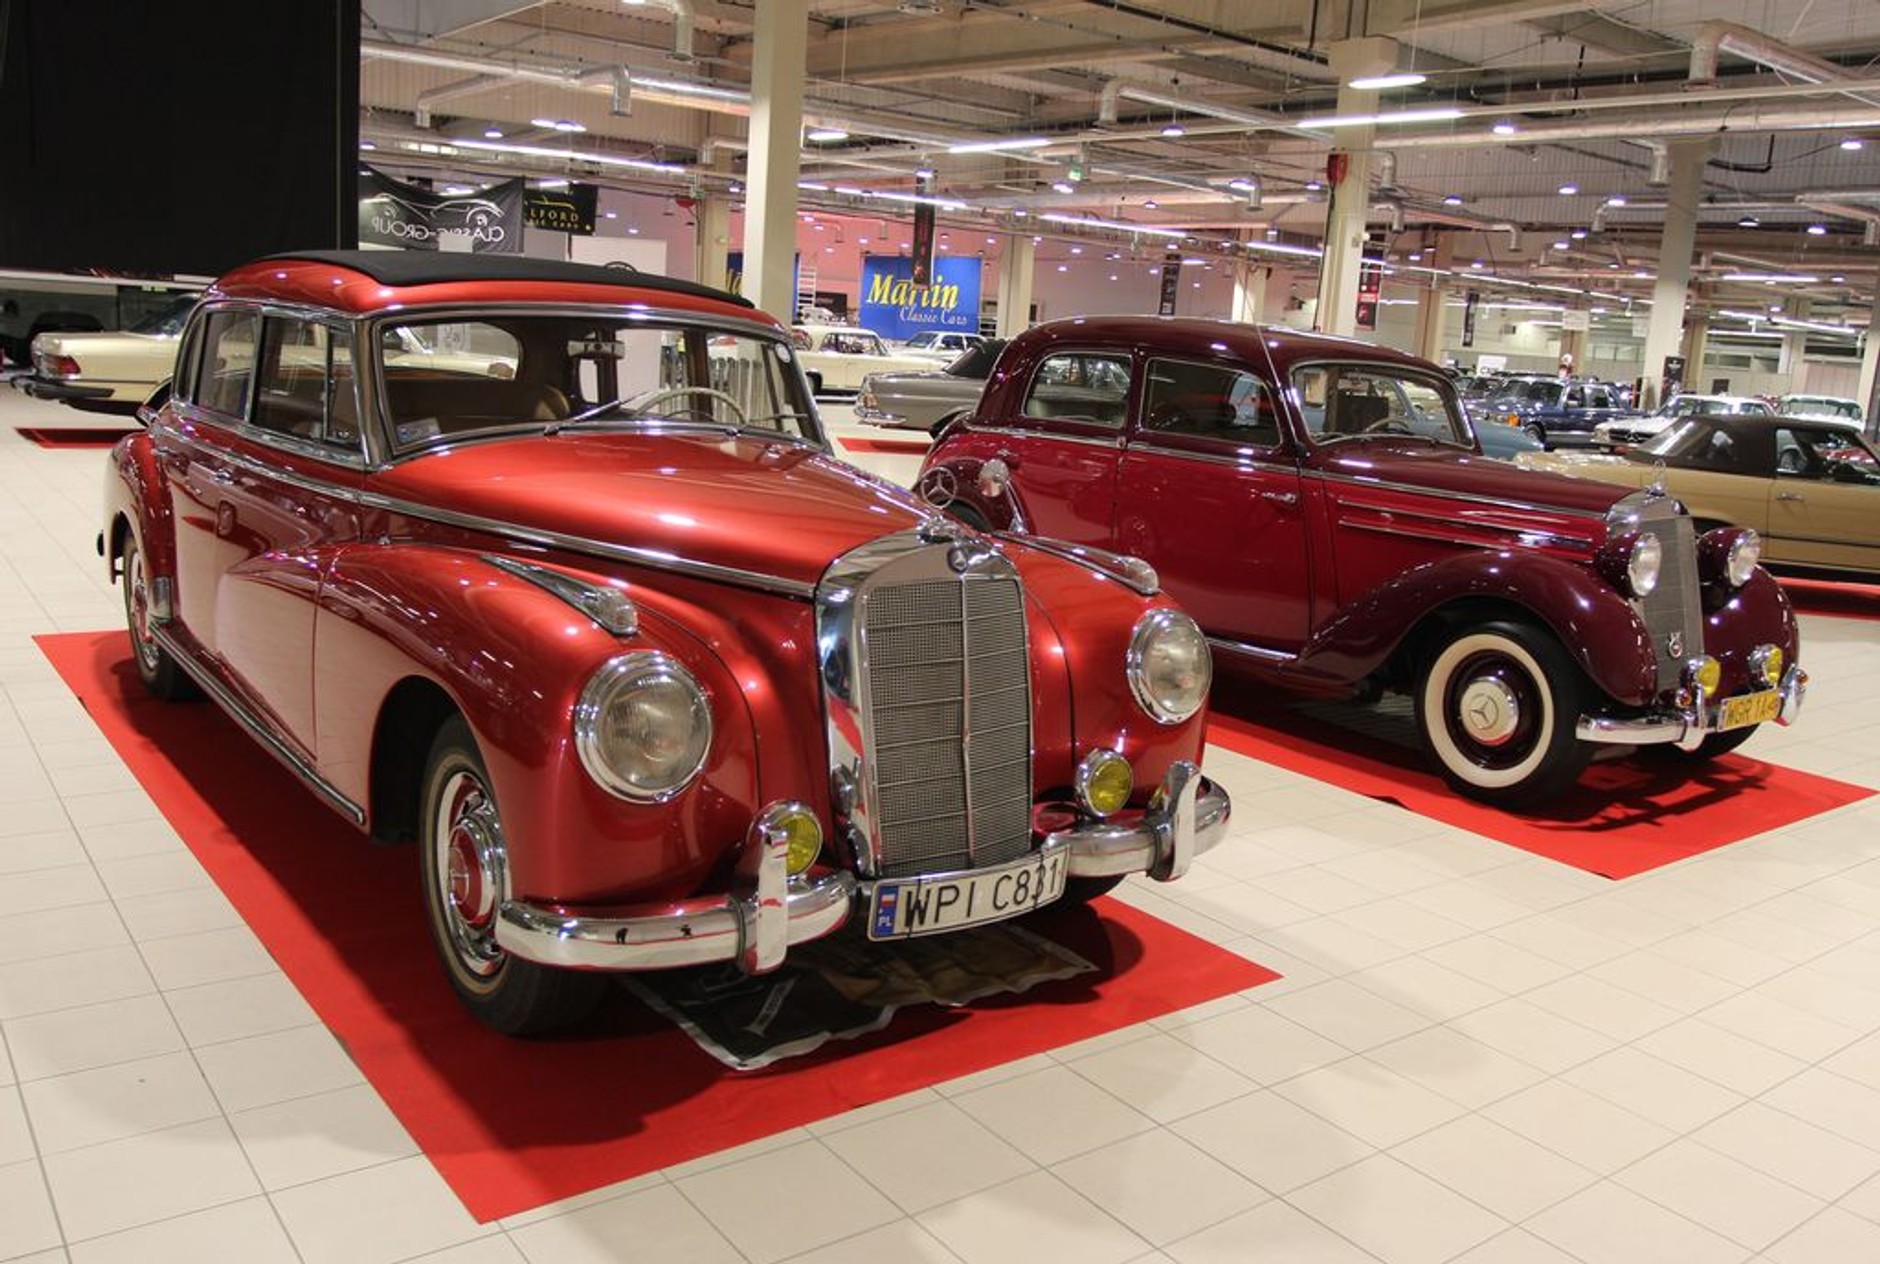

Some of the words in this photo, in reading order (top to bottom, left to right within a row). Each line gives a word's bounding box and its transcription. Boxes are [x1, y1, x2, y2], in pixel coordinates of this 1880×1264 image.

[899, 303, 939, 323] Classic
[940, 309, 968, 326] Cars
[904, 881, 976, 928] WPI
[992, 858, 1059, 911] C831
[877, 914, 894, 928] PL
